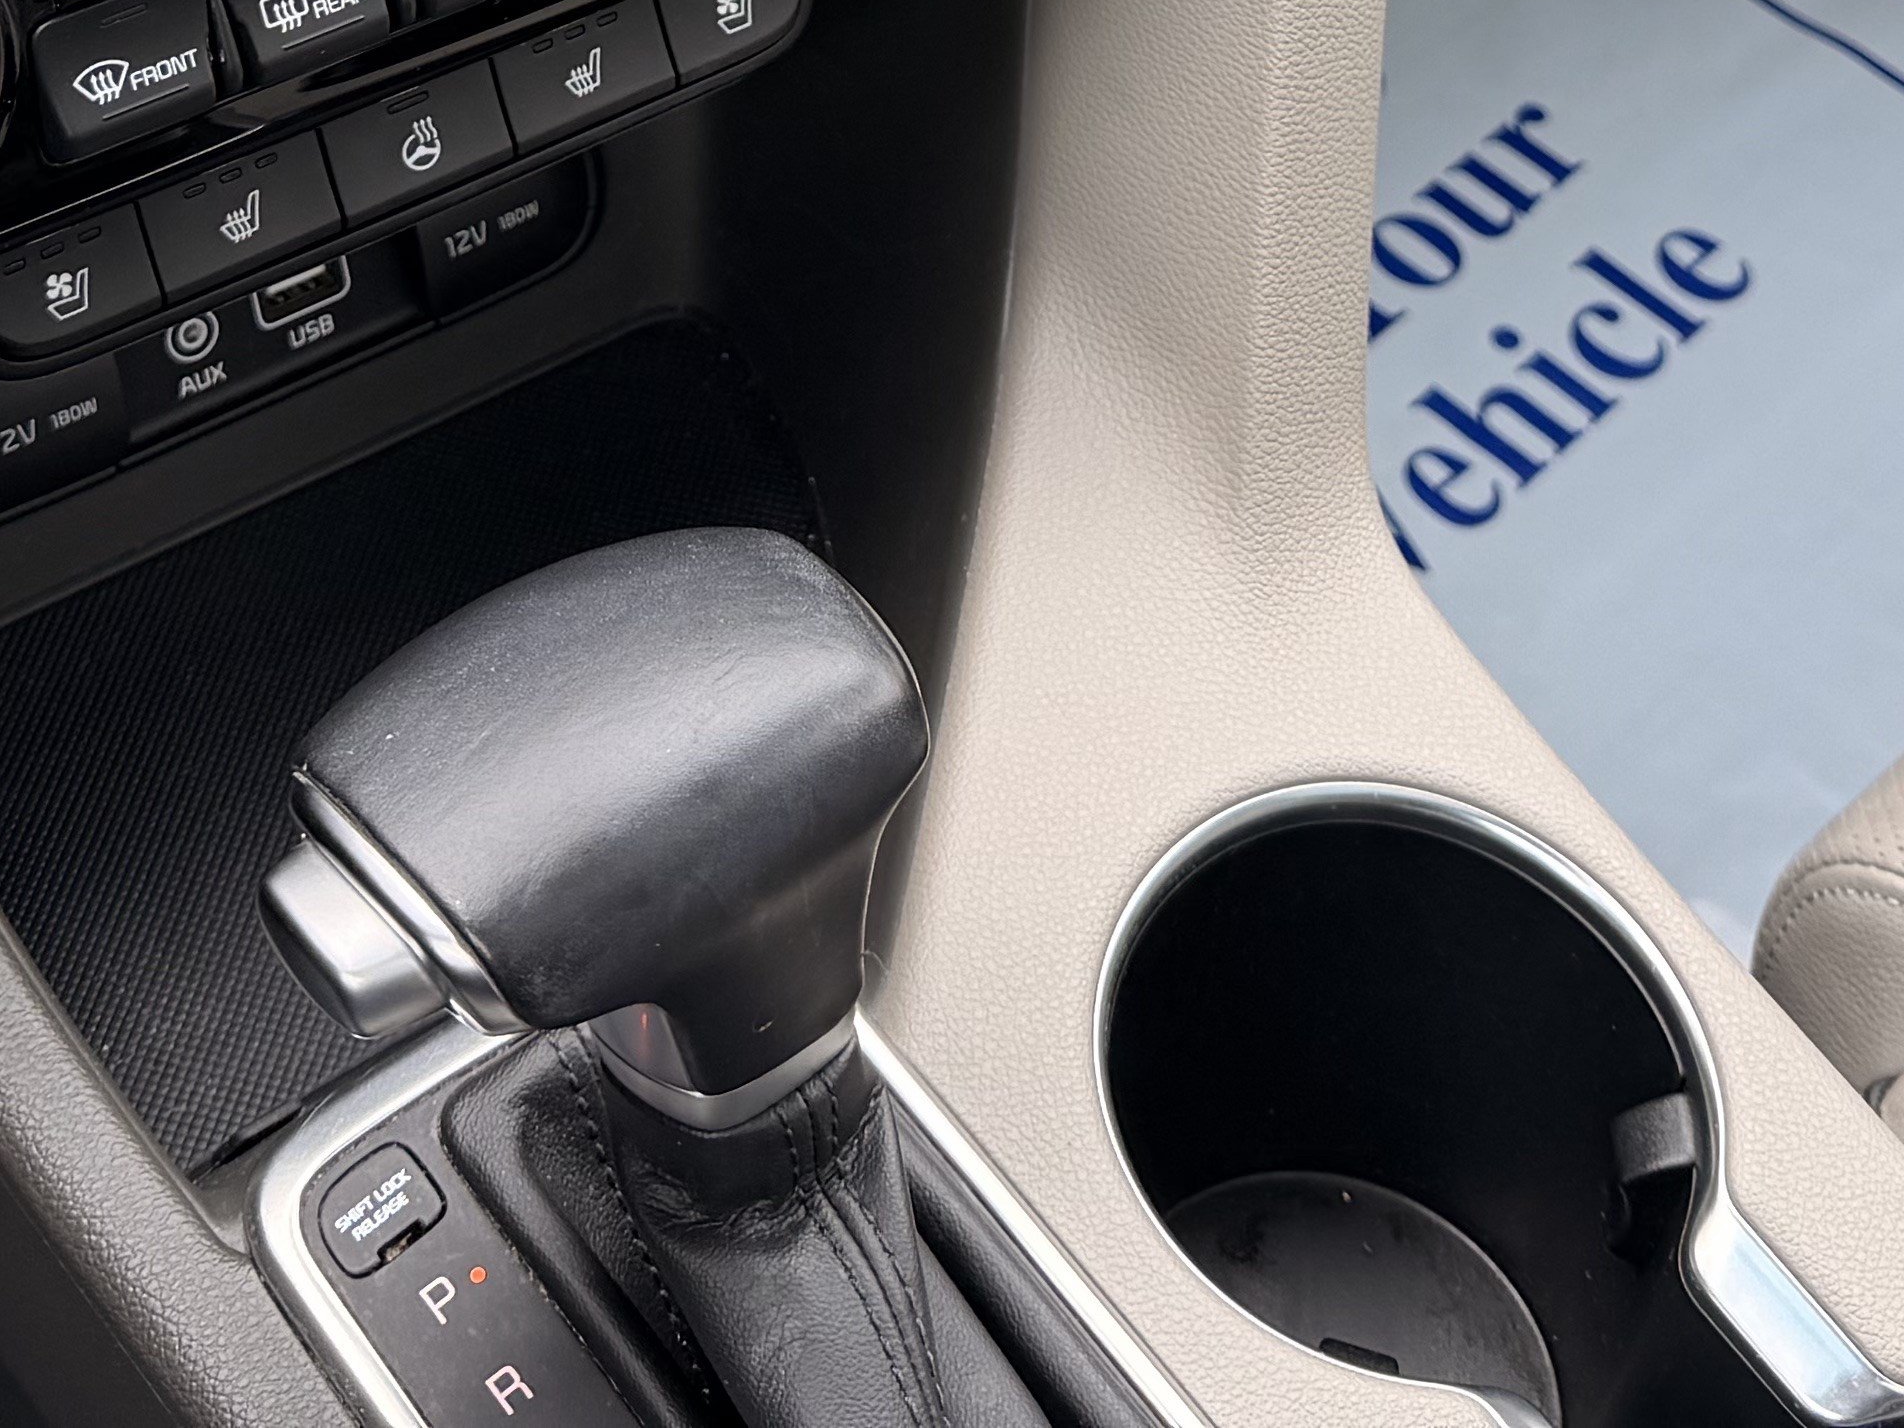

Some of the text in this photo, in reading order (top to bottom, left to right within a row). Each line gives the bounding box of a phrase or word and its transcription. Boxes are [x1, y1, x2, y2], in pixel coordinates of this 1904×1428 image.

[129, 47, 199, 95] FRONT
[443, 220, 489, 259] 12V
[287, 312, 336, 350] USB
[176, 360, 228, 400] AUX
[1375, 224, 1755, 572] ehicle
[334, 1166, 413, 1234] SHIFT LOCK
[350, 1190, 411, 1242] RELEASE
[418, 1275, 457, 1326] P
[484, 1364, 535, 1416] R
